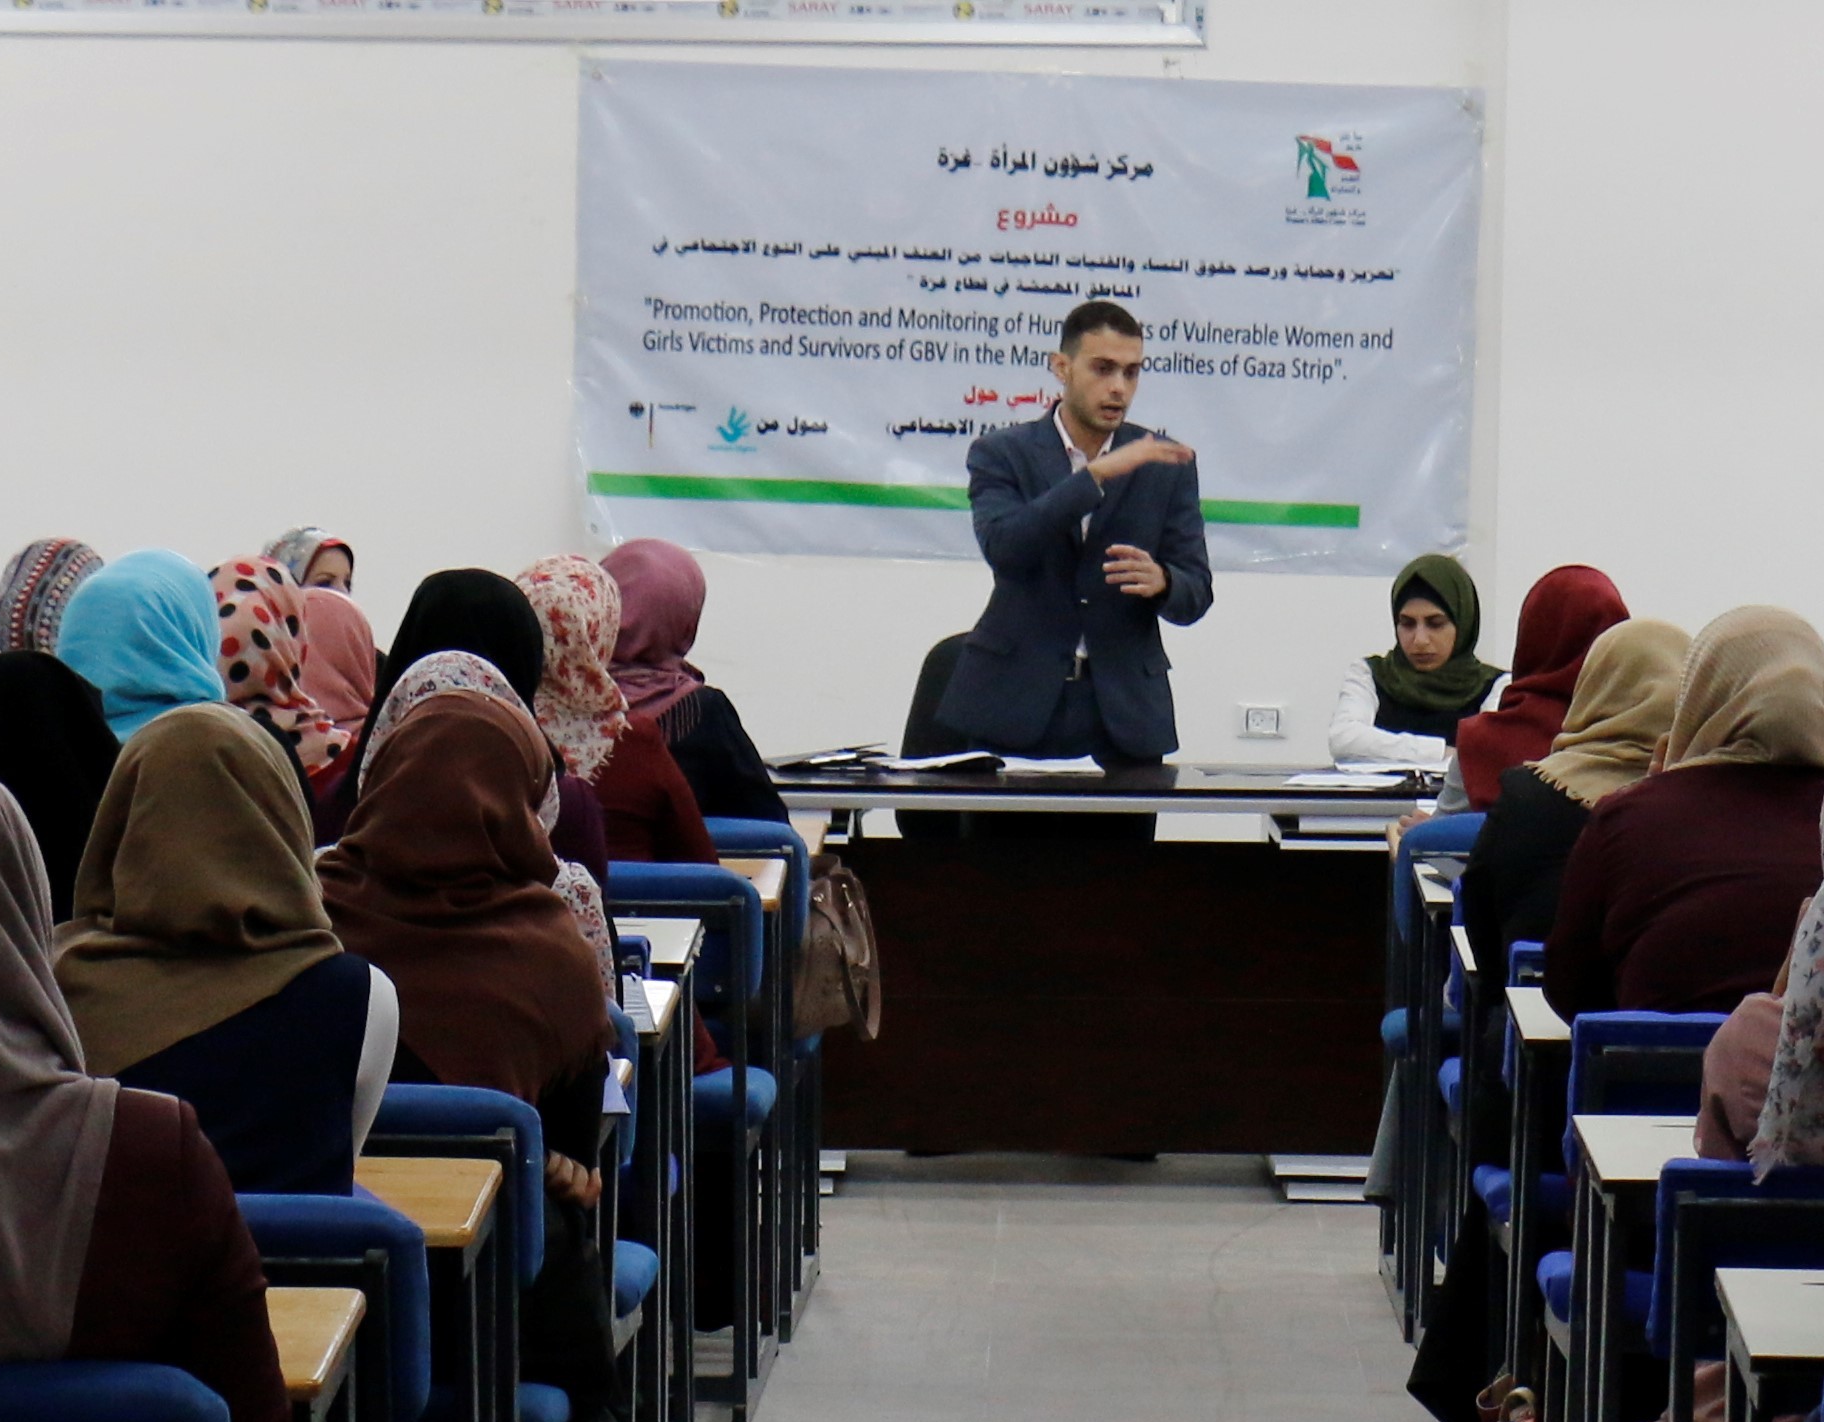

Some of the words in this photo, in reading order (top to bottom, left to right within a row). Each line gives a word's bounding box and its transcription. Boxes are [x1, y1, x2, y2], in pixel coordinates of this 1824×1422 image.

[990, 142, 1037, 176] المرأة
[1044, 152, 1100, 179] شؤون
[1105, 154, 1155, 181] مركز
[997, 202, 1079, 232] مشروع
[653, 236, 668, 257] في
[762, 241, 804, 258] النوع
[808, 243, 841, 259] على
[903, 246, 952, 262] العنف
[958, 251, 982, 266] من
[1194, 258, 1237, 278] حقوق
[919, 275, 947, 292] غزة
[994, 277, 1010, 297] في
[644, 297, 753, 327] "Promotion,
[760, 302, 853, 326] Protection
[858, 307, 892, 328] and
[898, 307, 999, 337] Monitoring
[1005, 310, 1023, 334] of
[1159, 319, 1178, 342] of
[1183, 321, 1279, 347] Vulnerable
[1285, 326, 1354, 349] Women
[1360, 328, 1394, 350] and
[642, 329, 683, 352] Girls
[688, 330, 754, 354] Victims
[760, 334, 793, 356] and
[798, 335, 881, 360] Survivors
[886, 338, 906, 361] of
[910, 340, 949, 363] GBV
[953, 342, 970, 365] in
[976, 342, 1005, 366] the
[1141, 351, 1215, 376] ocalities
[1220, 354, 1240, 377] of
[1244, 356, 1286, 379] Gaza
[1291, 357, 1348, 384] Strip".
[964, 385, 999, 405] حول
[756, 419, 779, 435] من
